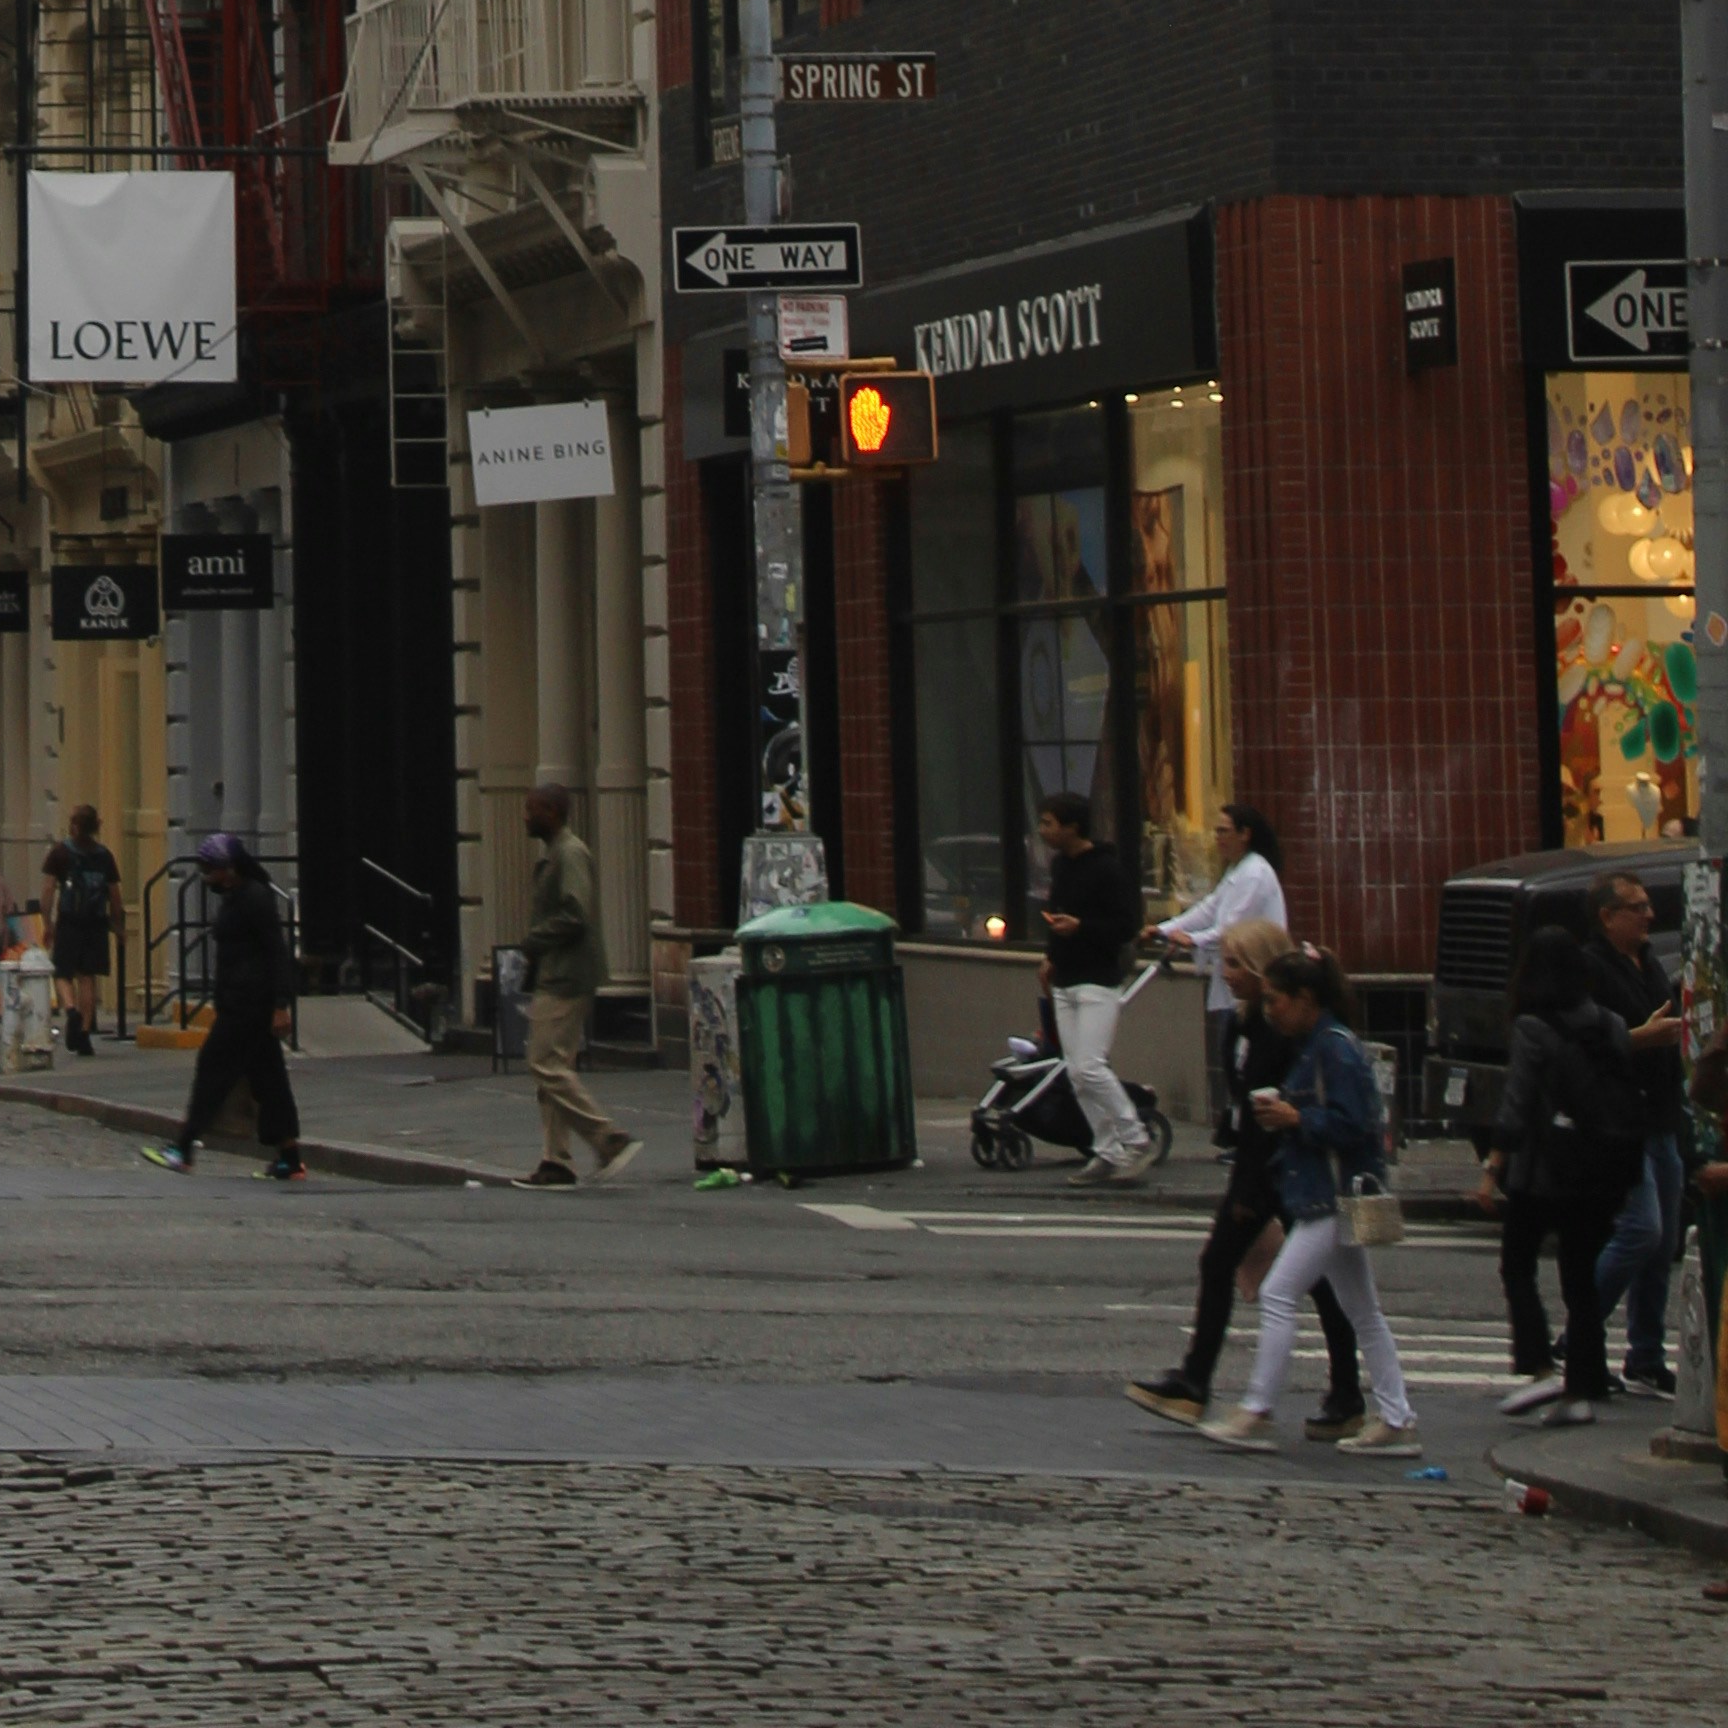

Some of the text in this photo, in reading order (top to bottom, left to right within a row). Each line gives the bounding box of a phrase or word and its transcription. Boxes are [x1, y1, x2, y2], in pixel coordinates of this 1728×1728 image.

[790, 63, 926, 99] SPRING ST
[705, 245, 834, 271] ONE WAY
[1614, 292, 1687, 328] ONE
[50, 320, 216, 361] LOEWE
[914, 283, 1102, 376] KENDRA SCOTT
[478, 440, 605, 464] ANINE BING
[188, 549, 246, 575] ami
